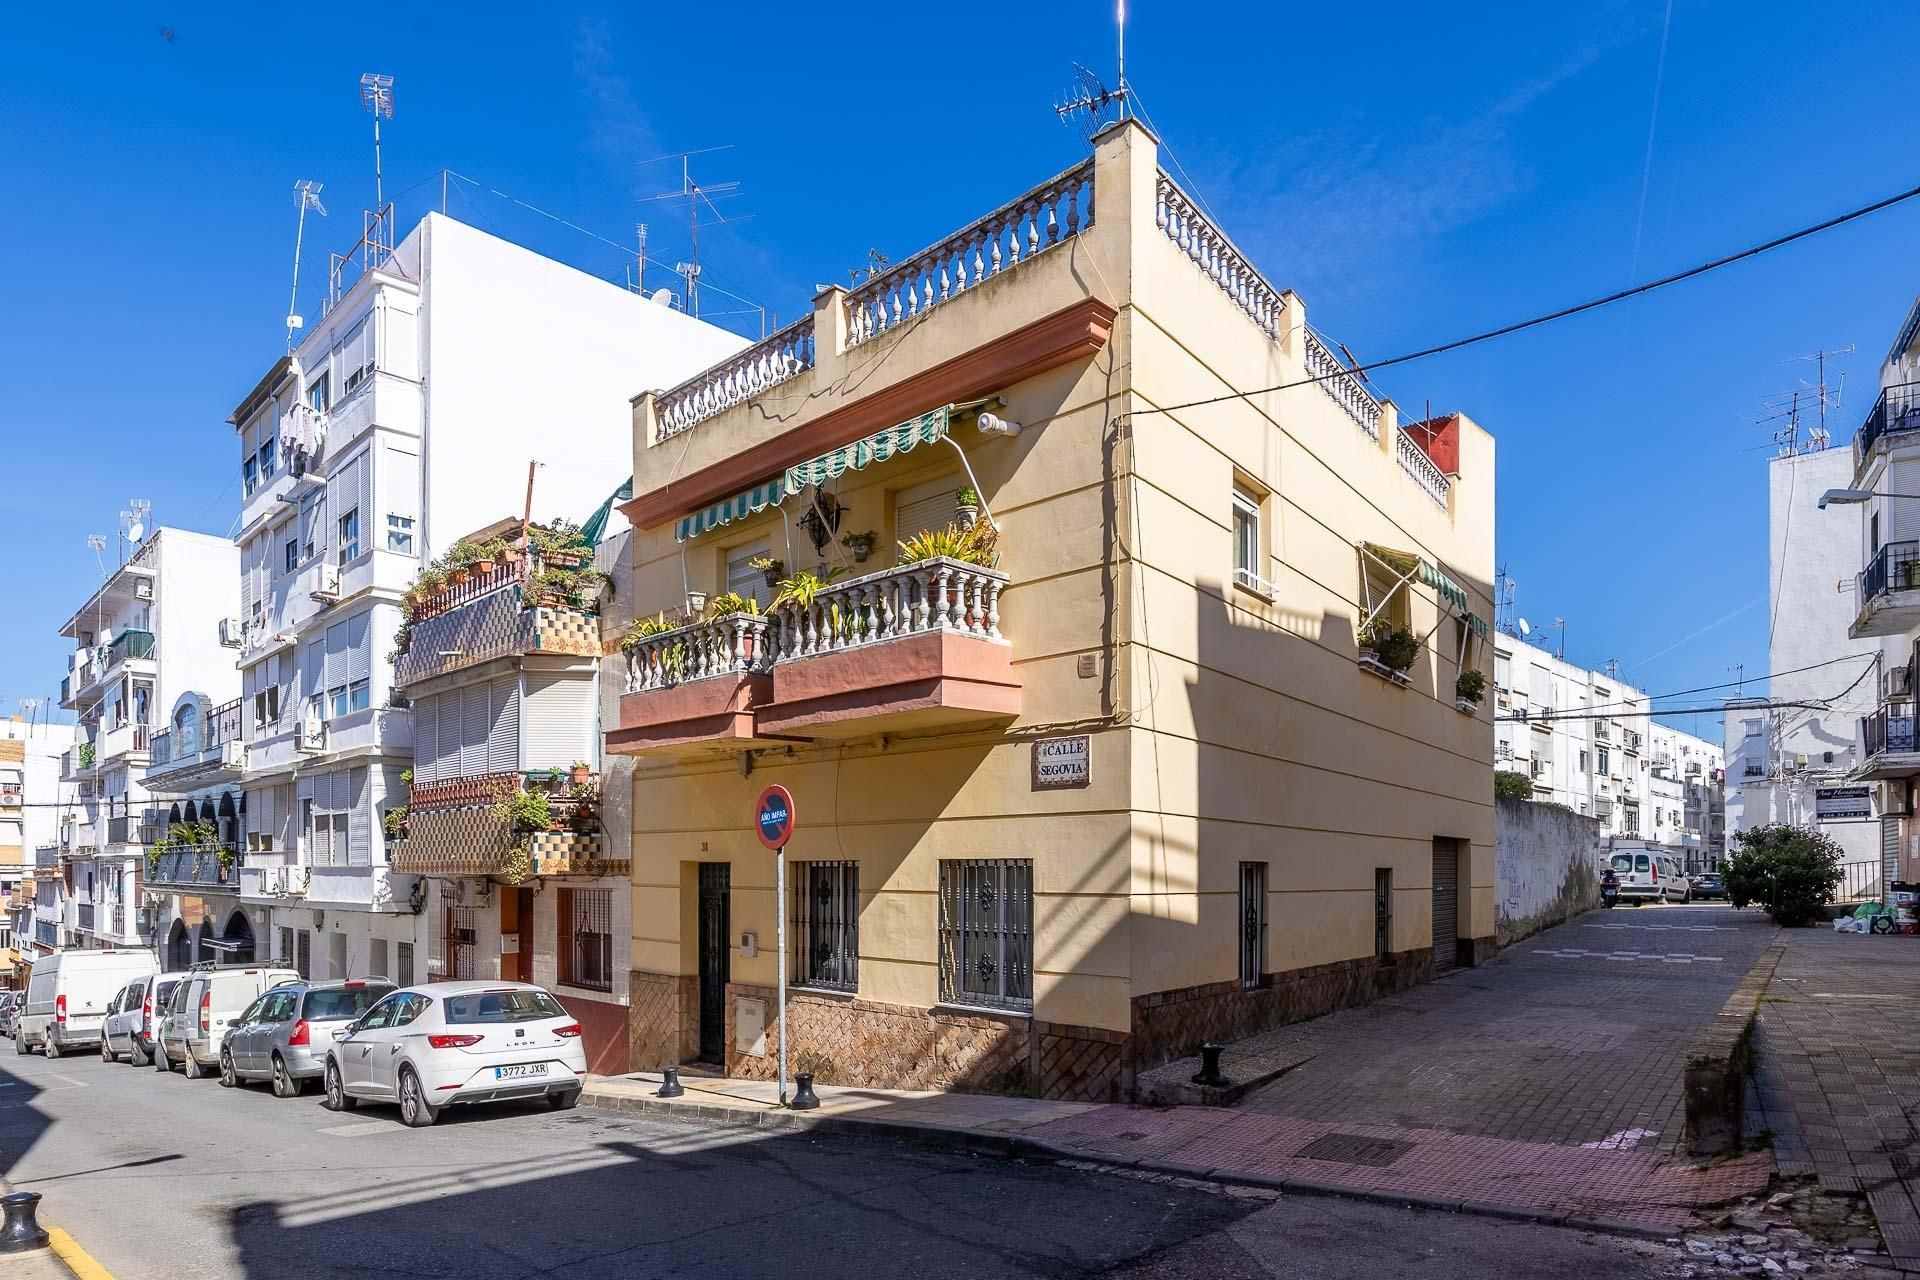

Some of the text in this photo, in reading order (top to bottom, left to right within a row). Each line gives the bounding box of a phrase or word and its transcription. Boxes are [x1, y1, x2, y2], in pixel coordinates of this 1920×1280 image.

[1048, 743, 1083, 756] CALLE
[1041, 763, 1083, 776] SEGOVIA
[761, 812, 770, 822] AÑO
[502, 1064, 546, 1077] 3772 JXR
